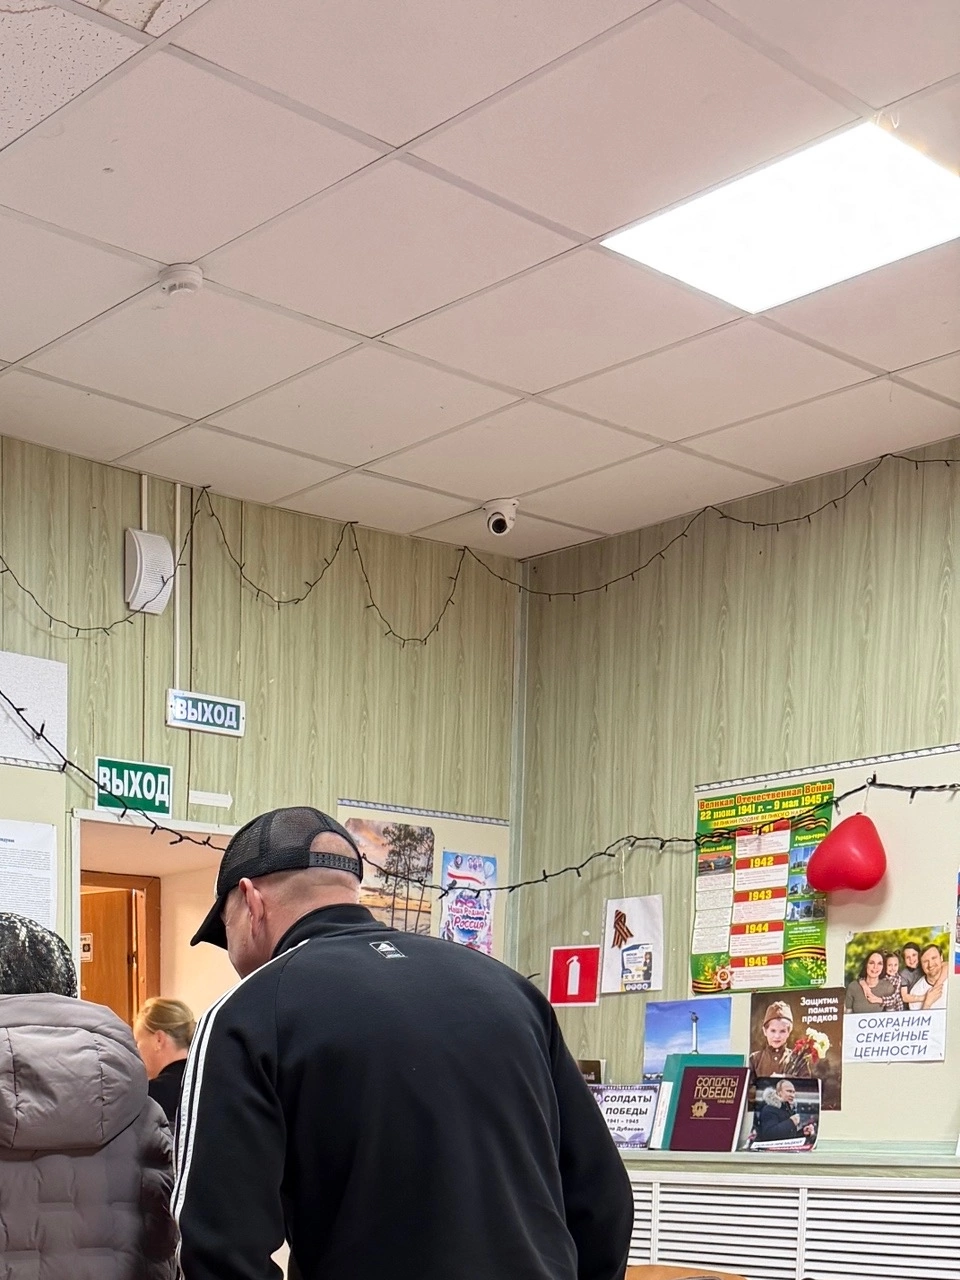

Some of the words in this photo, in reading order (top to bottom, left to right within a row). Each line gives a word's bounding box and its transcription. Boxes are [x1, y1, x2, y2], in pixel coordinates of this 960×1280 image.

[174, 697, 237, 729] ВЫХОД
[99, 766, 169, 808] ВЫХОД
[699, 798, 735, 810] Великая
[736, 787, 802, 805] Отечественная
[804, 783, 833, 795] Война
[700, 811, 712, 820] 22
[713, 809, 736, 819] июня
[738, 803, 756, 815] 1941
[774, 800, 780, 810] 9
[782, 799, 799, 809] мая
[801, 794, 822, 806] 1945
[750, 857, 774, 868] 1942
[749, 890, 772, 901] 1943
[454, 916, 486, 929] Россия
[746, 923, 769, 934] 1944
[744, 956, 768, 967] 1945
[800, 996, 839, 1007] Защитим
[808, 1006, 838, 1015] память
[802, 1014, 838, 1024] предков
[858, 1016, 932, 1030] СОХРАНИМ
[856, 1029, 930, 1043] СЕМЕЙНЫЕ
[854, 1045, 928, 1059] ЦЕННОСТИ
[696, 1077, 739, 1087] СОЛДАТЫ
[694, 1086, 738, 1099] ПОБЕДЫ
[604, 1095, 653, 1104] СОЛДАТЫ
[605, 1107, 649, 1116] ПОБЕДЫ
